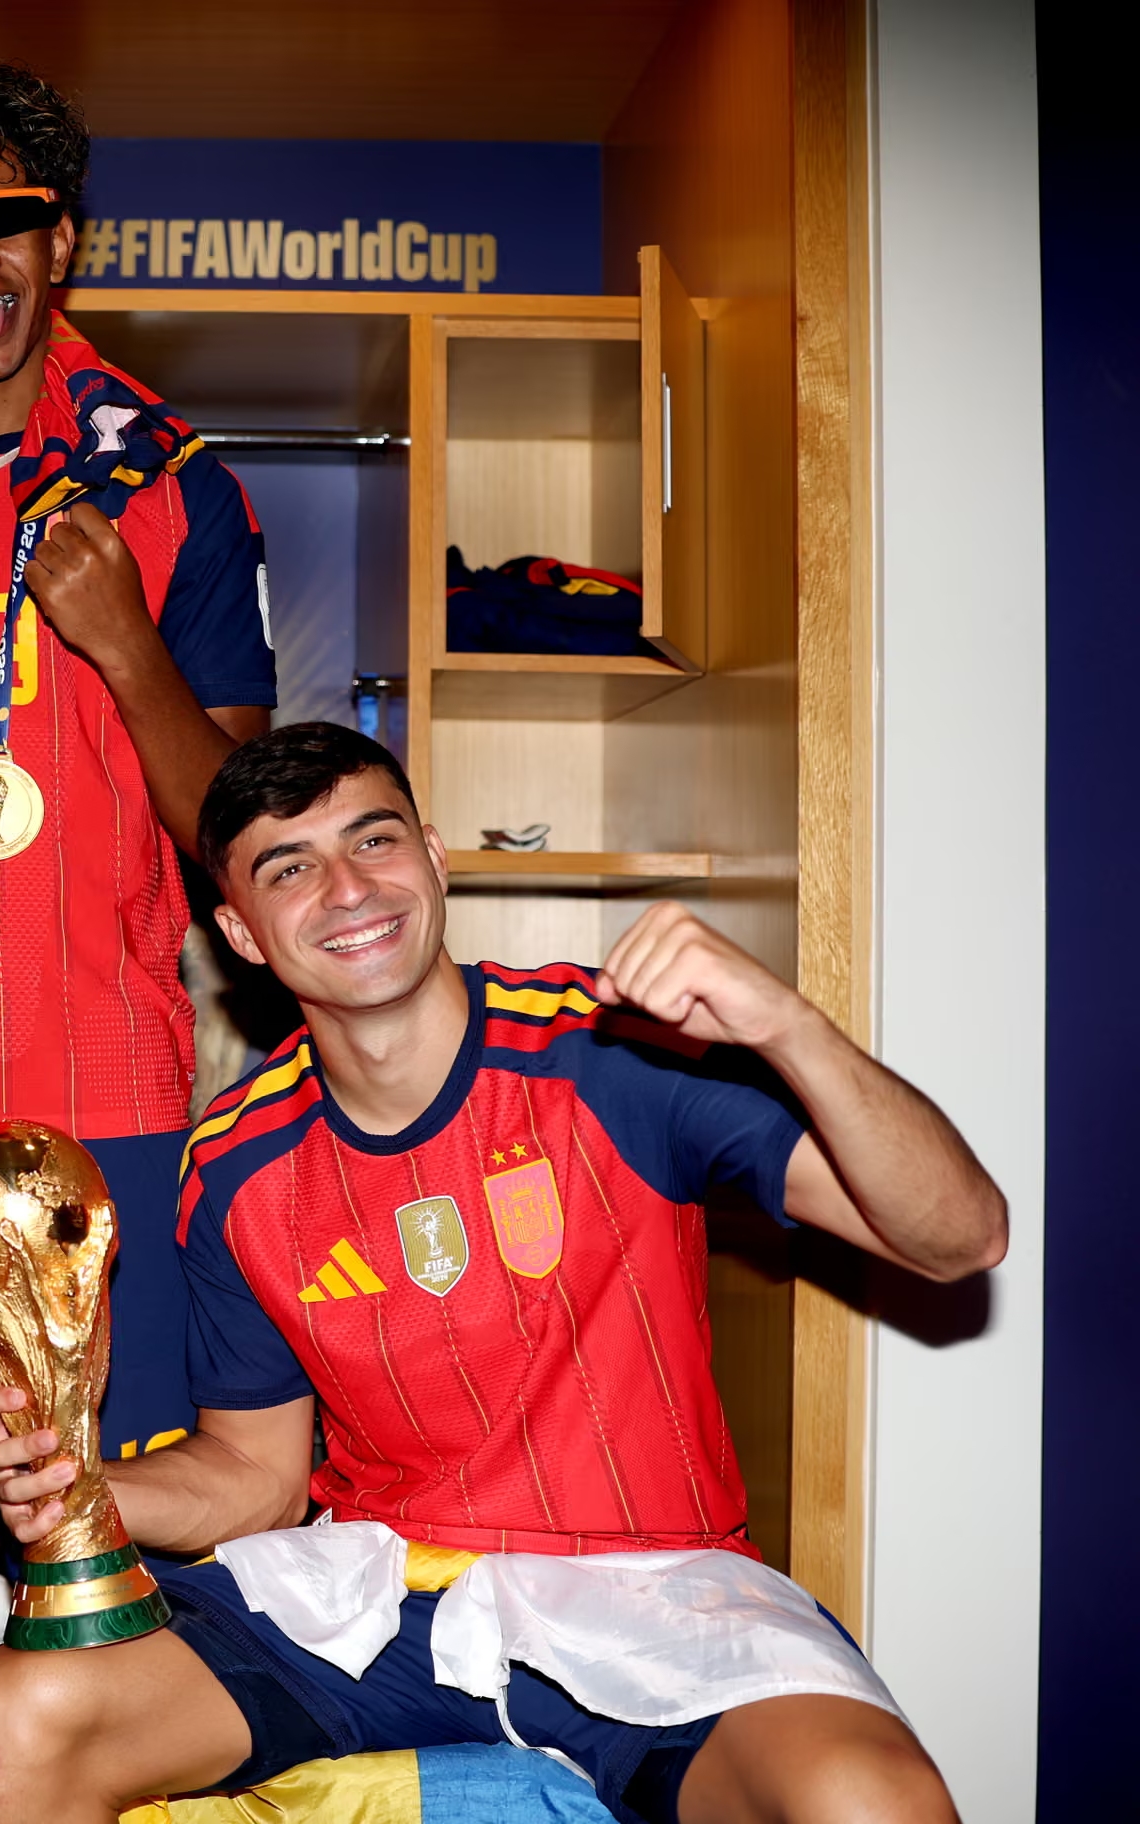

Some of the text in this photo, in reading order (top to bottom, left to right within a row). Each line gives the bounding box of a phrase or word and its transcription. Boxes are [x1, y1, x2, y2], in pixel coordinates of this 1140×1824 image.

[75, 218, 498, 293] #FIFAWorldCup
[12, 549, 29, 583] CUP
[423, 1256, 454, 1274] FIFA
